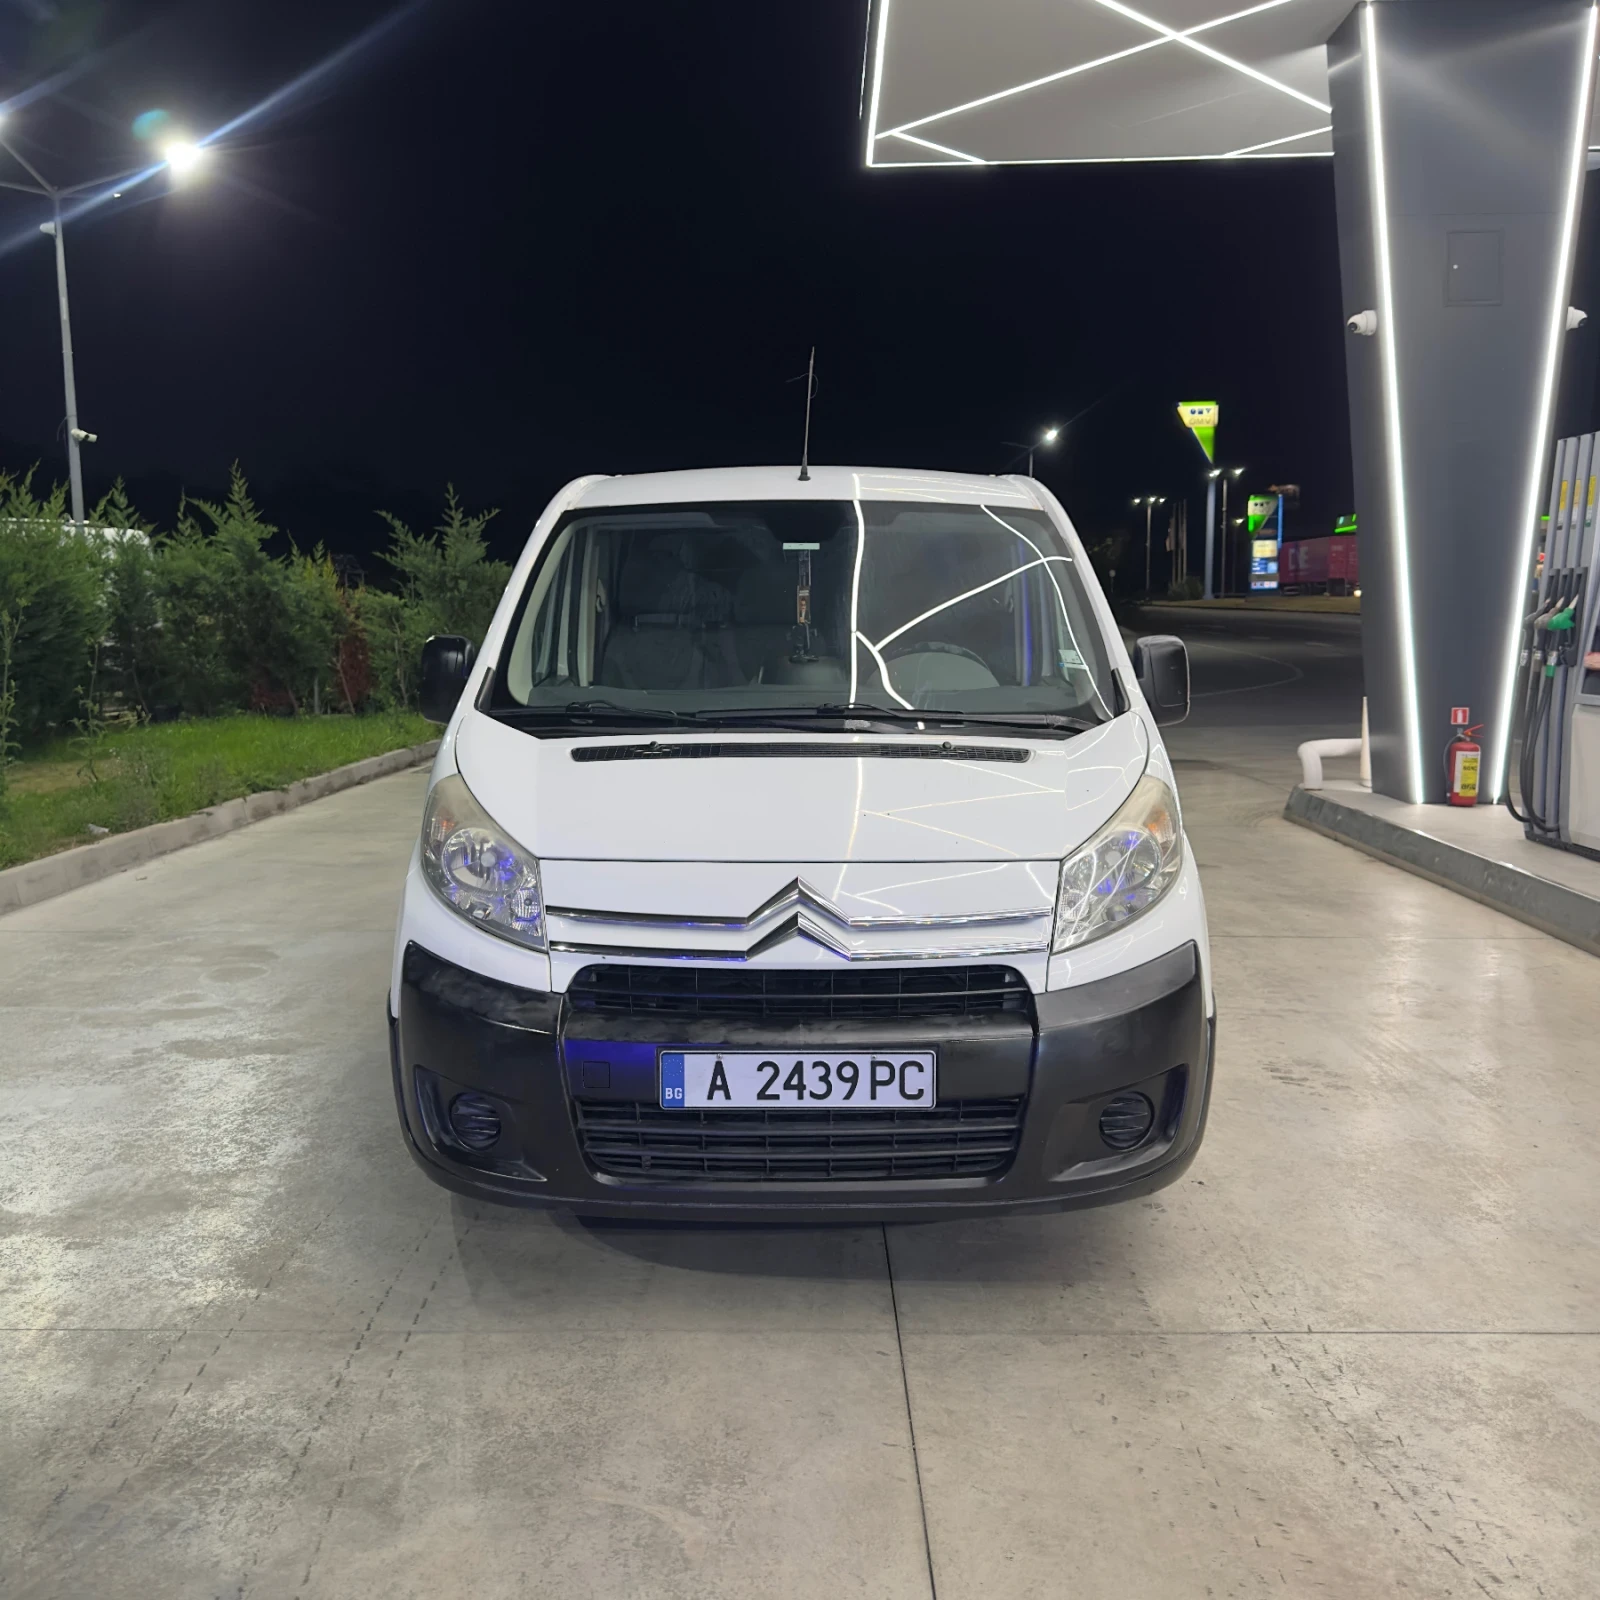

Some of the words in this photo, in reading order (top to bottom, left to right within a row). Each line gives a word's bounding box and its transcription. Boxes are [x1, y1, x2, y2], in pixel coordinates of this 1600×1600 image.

[707, 1060, 731, 1100] A
[756, 1060, 860, 1100] 2439
[870, 1060, 924, 1100] PC
[665, 1087, 683, 1100] BG
